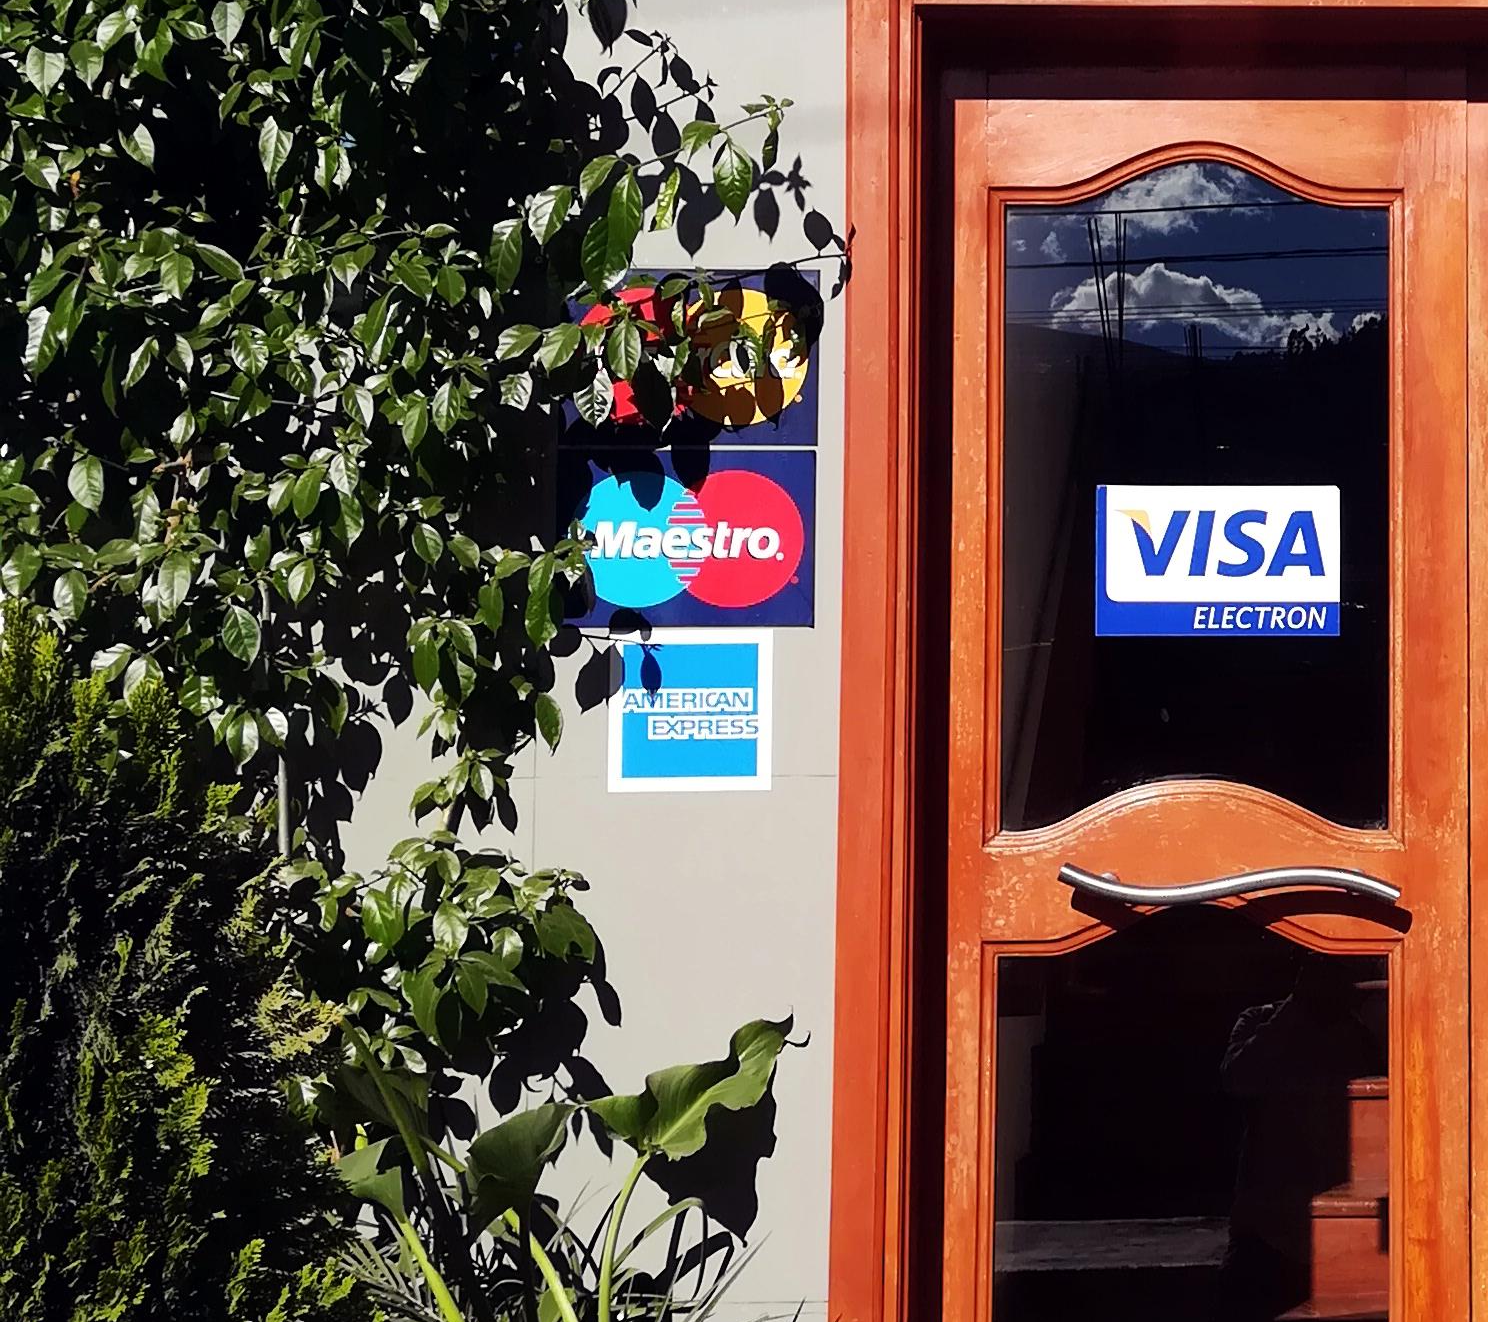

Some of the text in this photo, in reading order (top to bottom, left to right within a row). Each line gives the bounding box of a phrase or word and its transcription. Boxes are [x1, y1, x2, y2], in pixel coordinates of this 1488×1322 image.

[1114, 509, 1325, 577] VISA
[1193, 606, 1327, 630] ELECTRON
[623, 691, 749, 709] AMERICAN
[652, 719, 759, 736] EXPRESS
